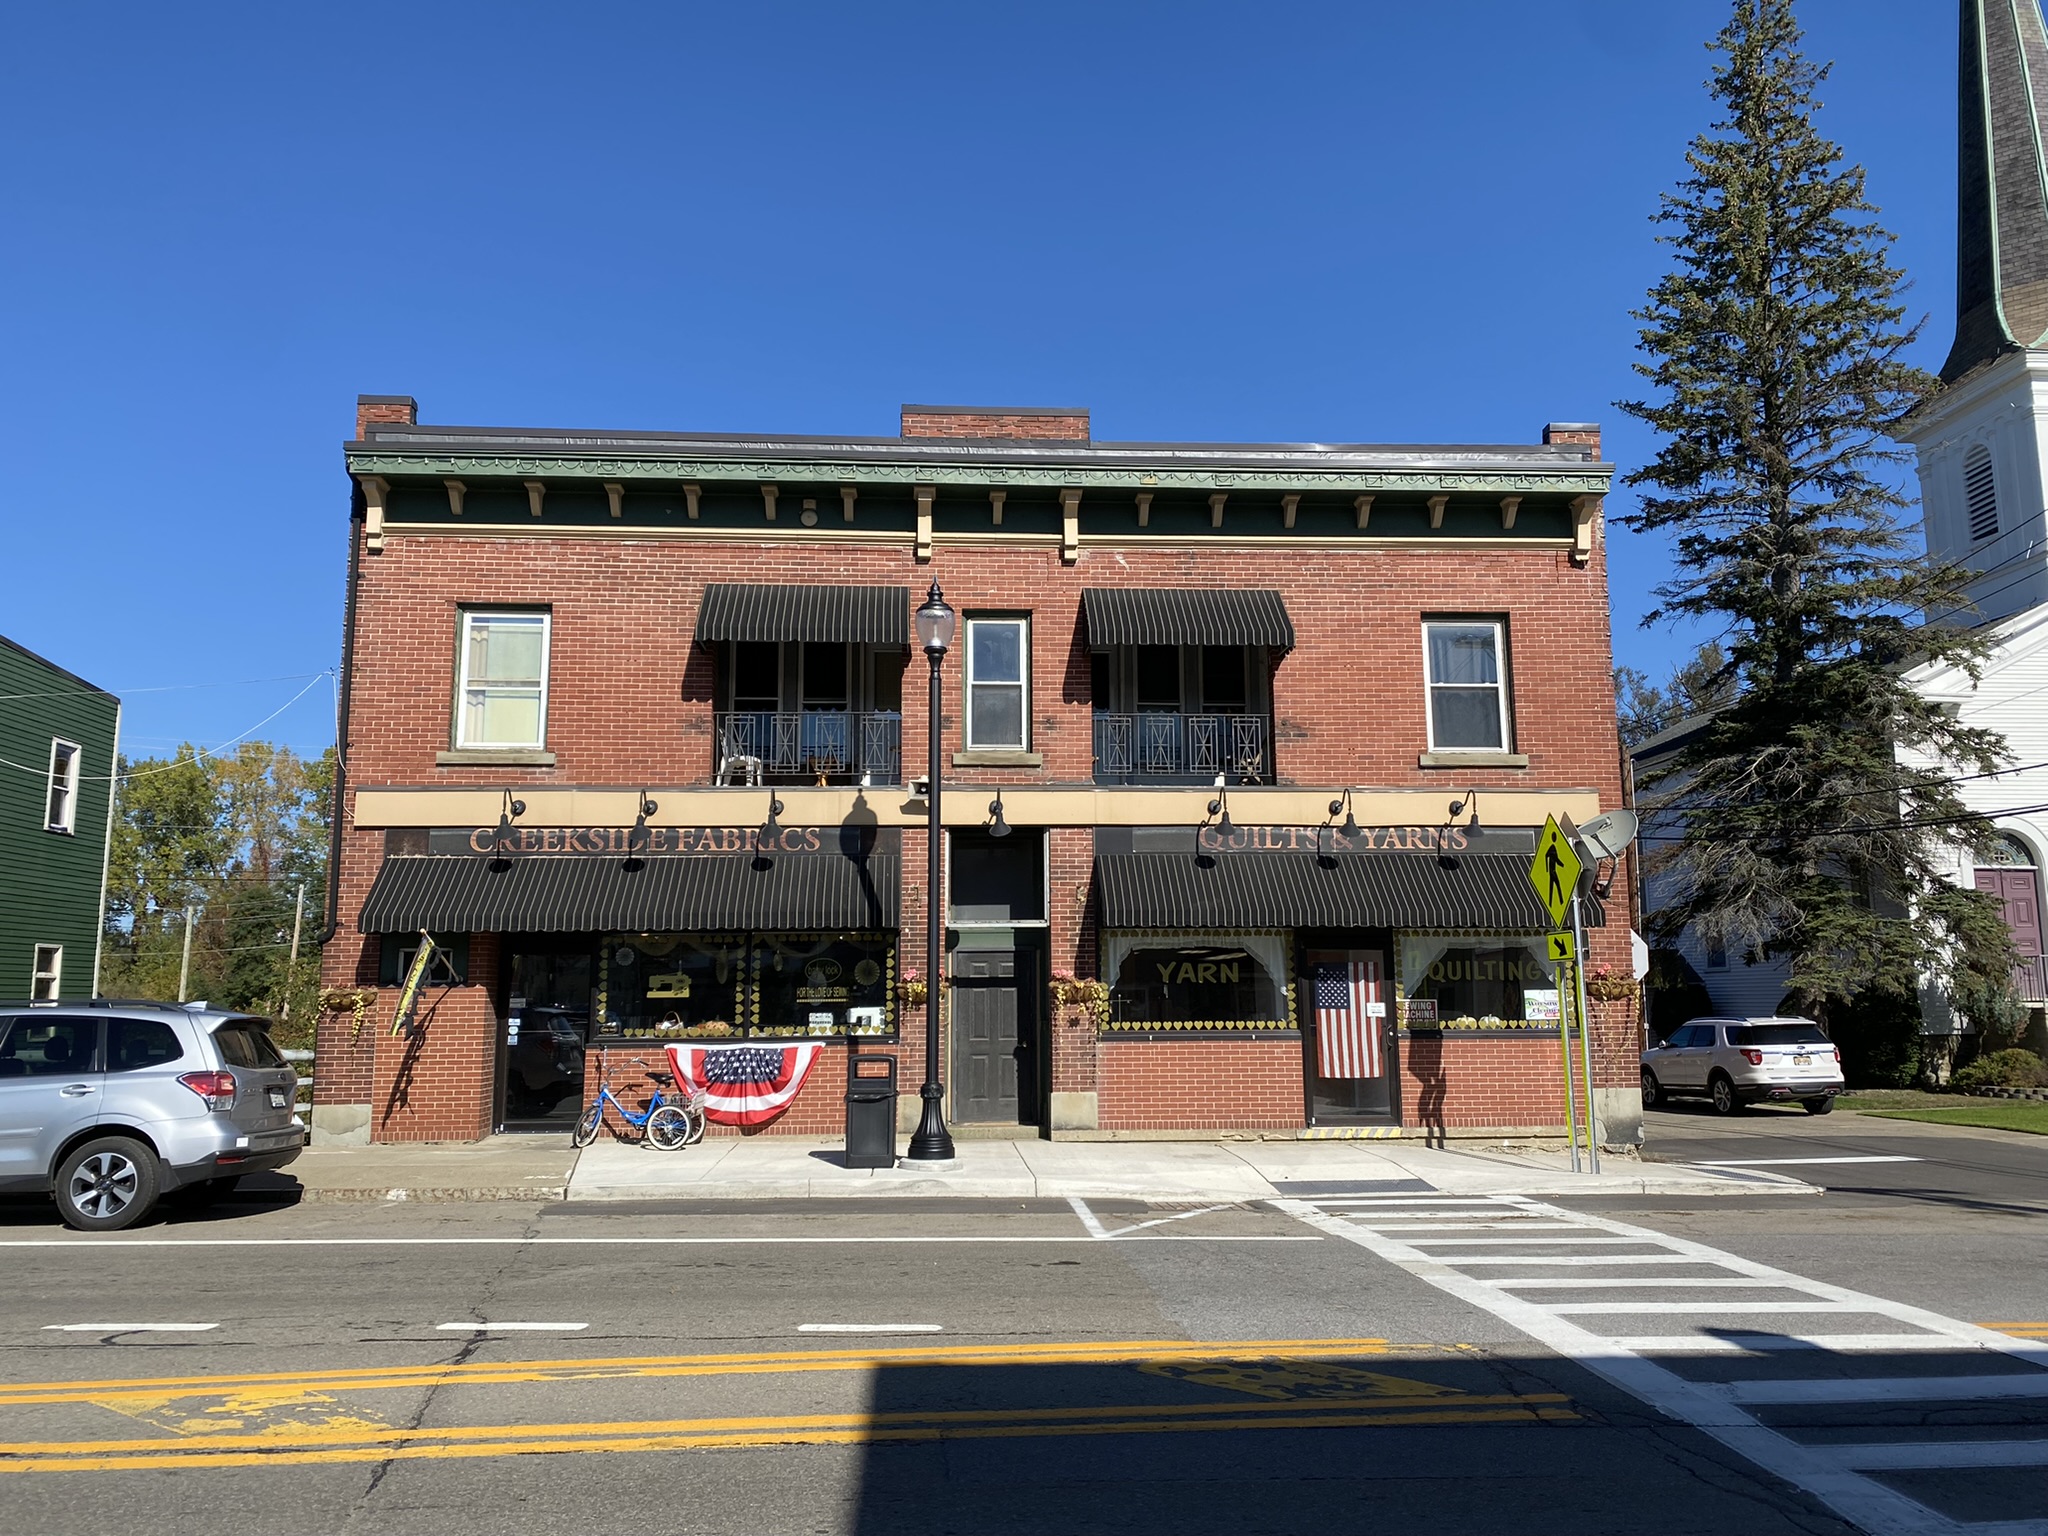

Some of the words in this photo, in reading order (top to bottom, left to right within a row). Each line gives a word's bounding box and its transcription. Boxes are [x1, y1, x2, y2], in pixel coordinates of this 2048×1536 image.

[469, 828, 667, 852] CREEKSIDE
[675, 828, 821, 851] FABRICS
[1199, 827, 1321, 850] QUILTS
[1330, 827, 1354, 850] &
[1362, 827, 1468, 850] YARNS
[1156, 961, 1239, 984] YARN
[1428, 959, 1542, 983] QUILTING
[796, 987, 806, 997] FOR
